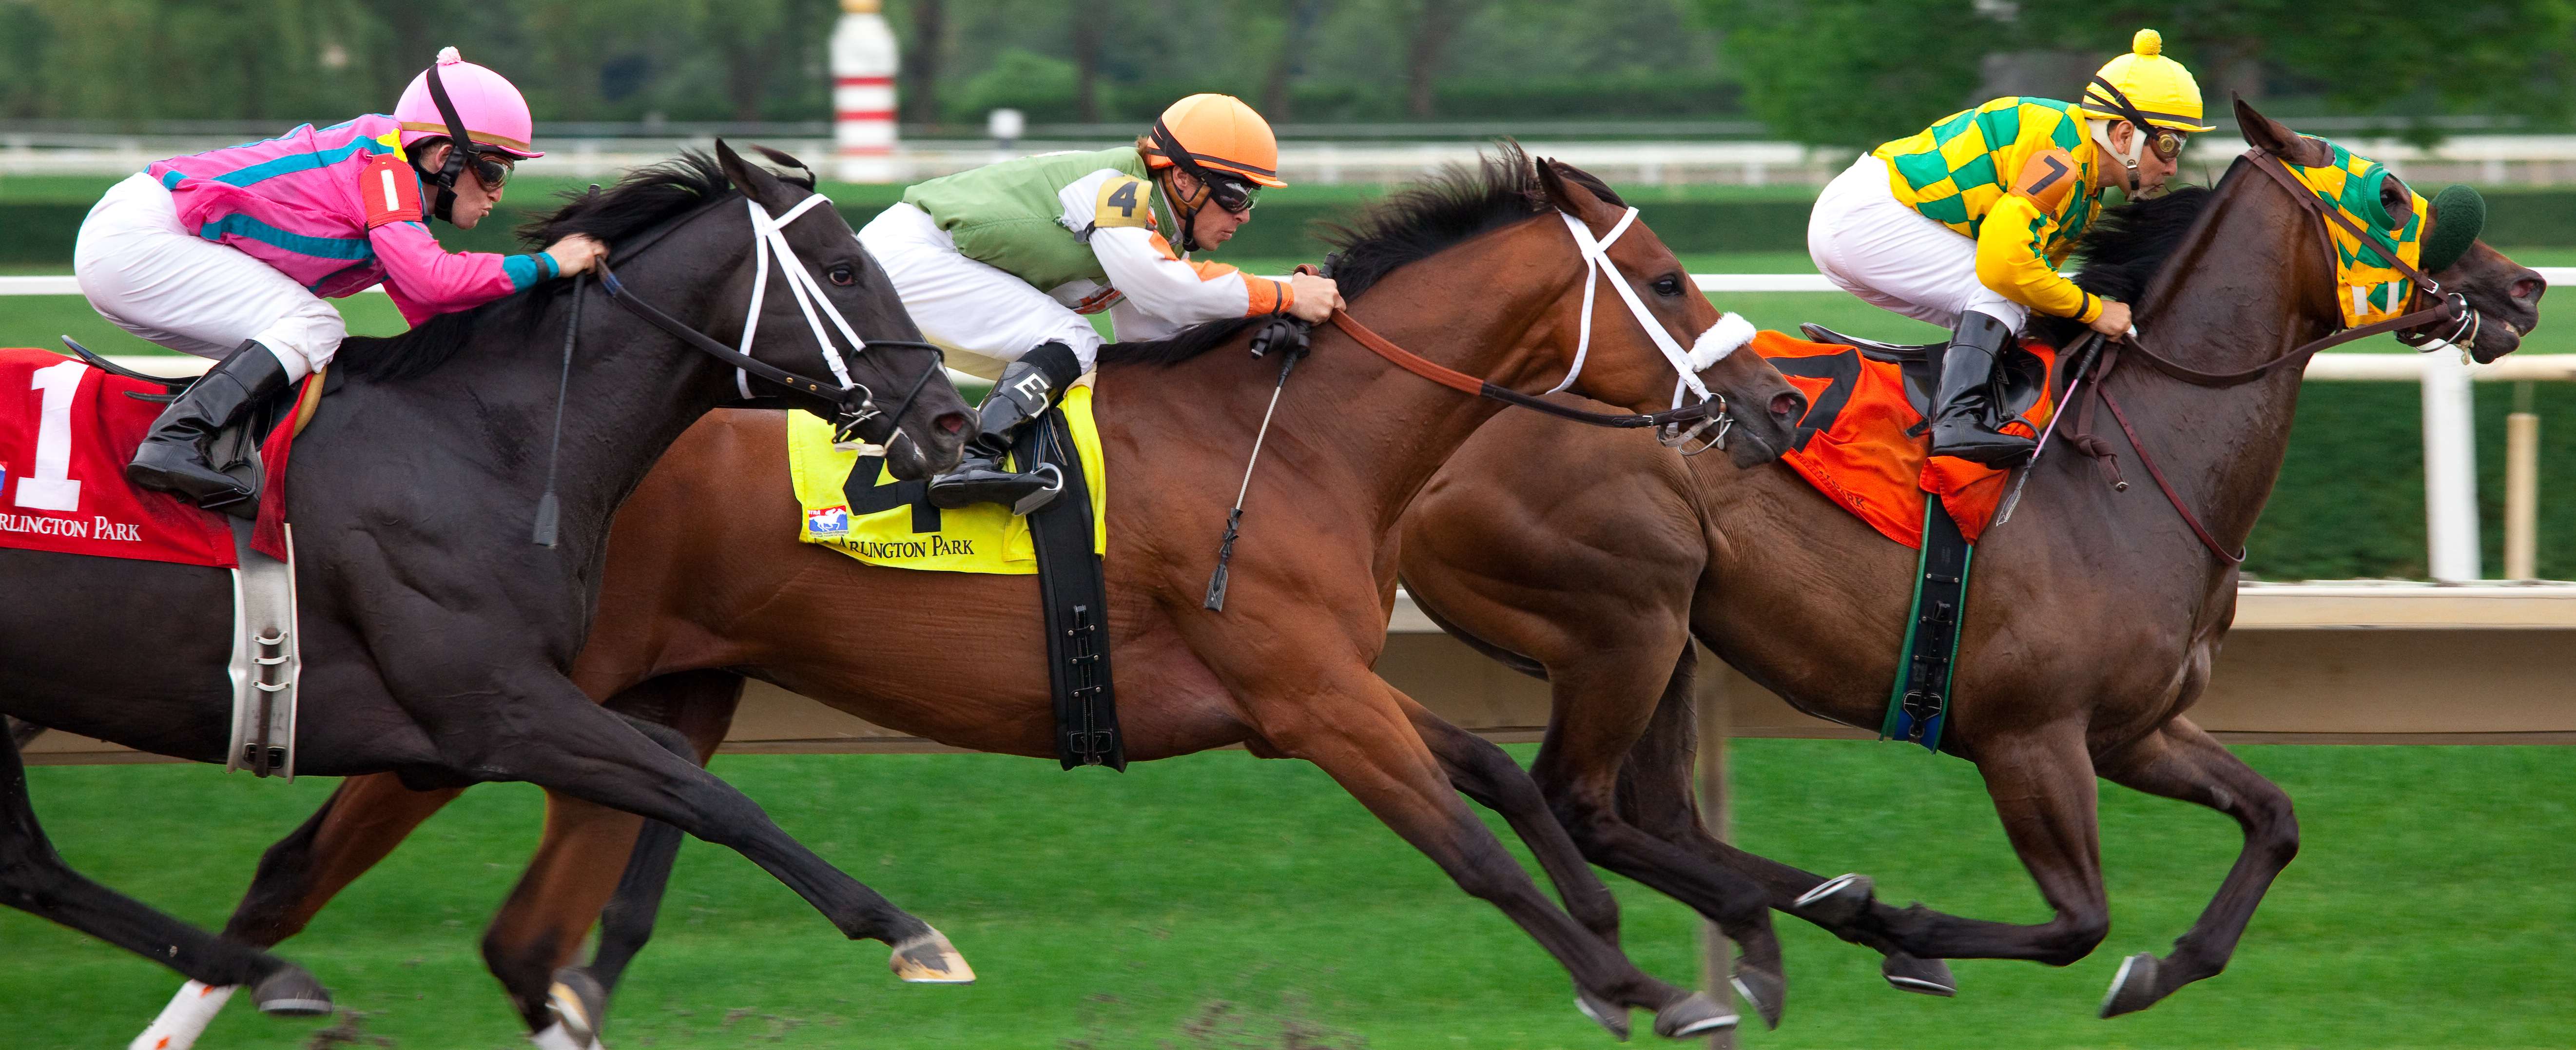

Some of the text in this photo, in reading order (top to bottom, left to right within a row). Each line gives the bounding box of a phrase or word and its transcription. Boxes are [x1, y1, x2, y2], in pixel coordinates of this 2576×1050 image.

[381, 169, 400, 212] 1
[2026, 155, 2069, 196] 7
[1108, 181, 1139, 217] 4
[1764, 347, 1862, 453] 7
[14, 360, 90, 512] 1
[93, 516, 142, 542] PARK
[931, 535, 974, 557] PARK
